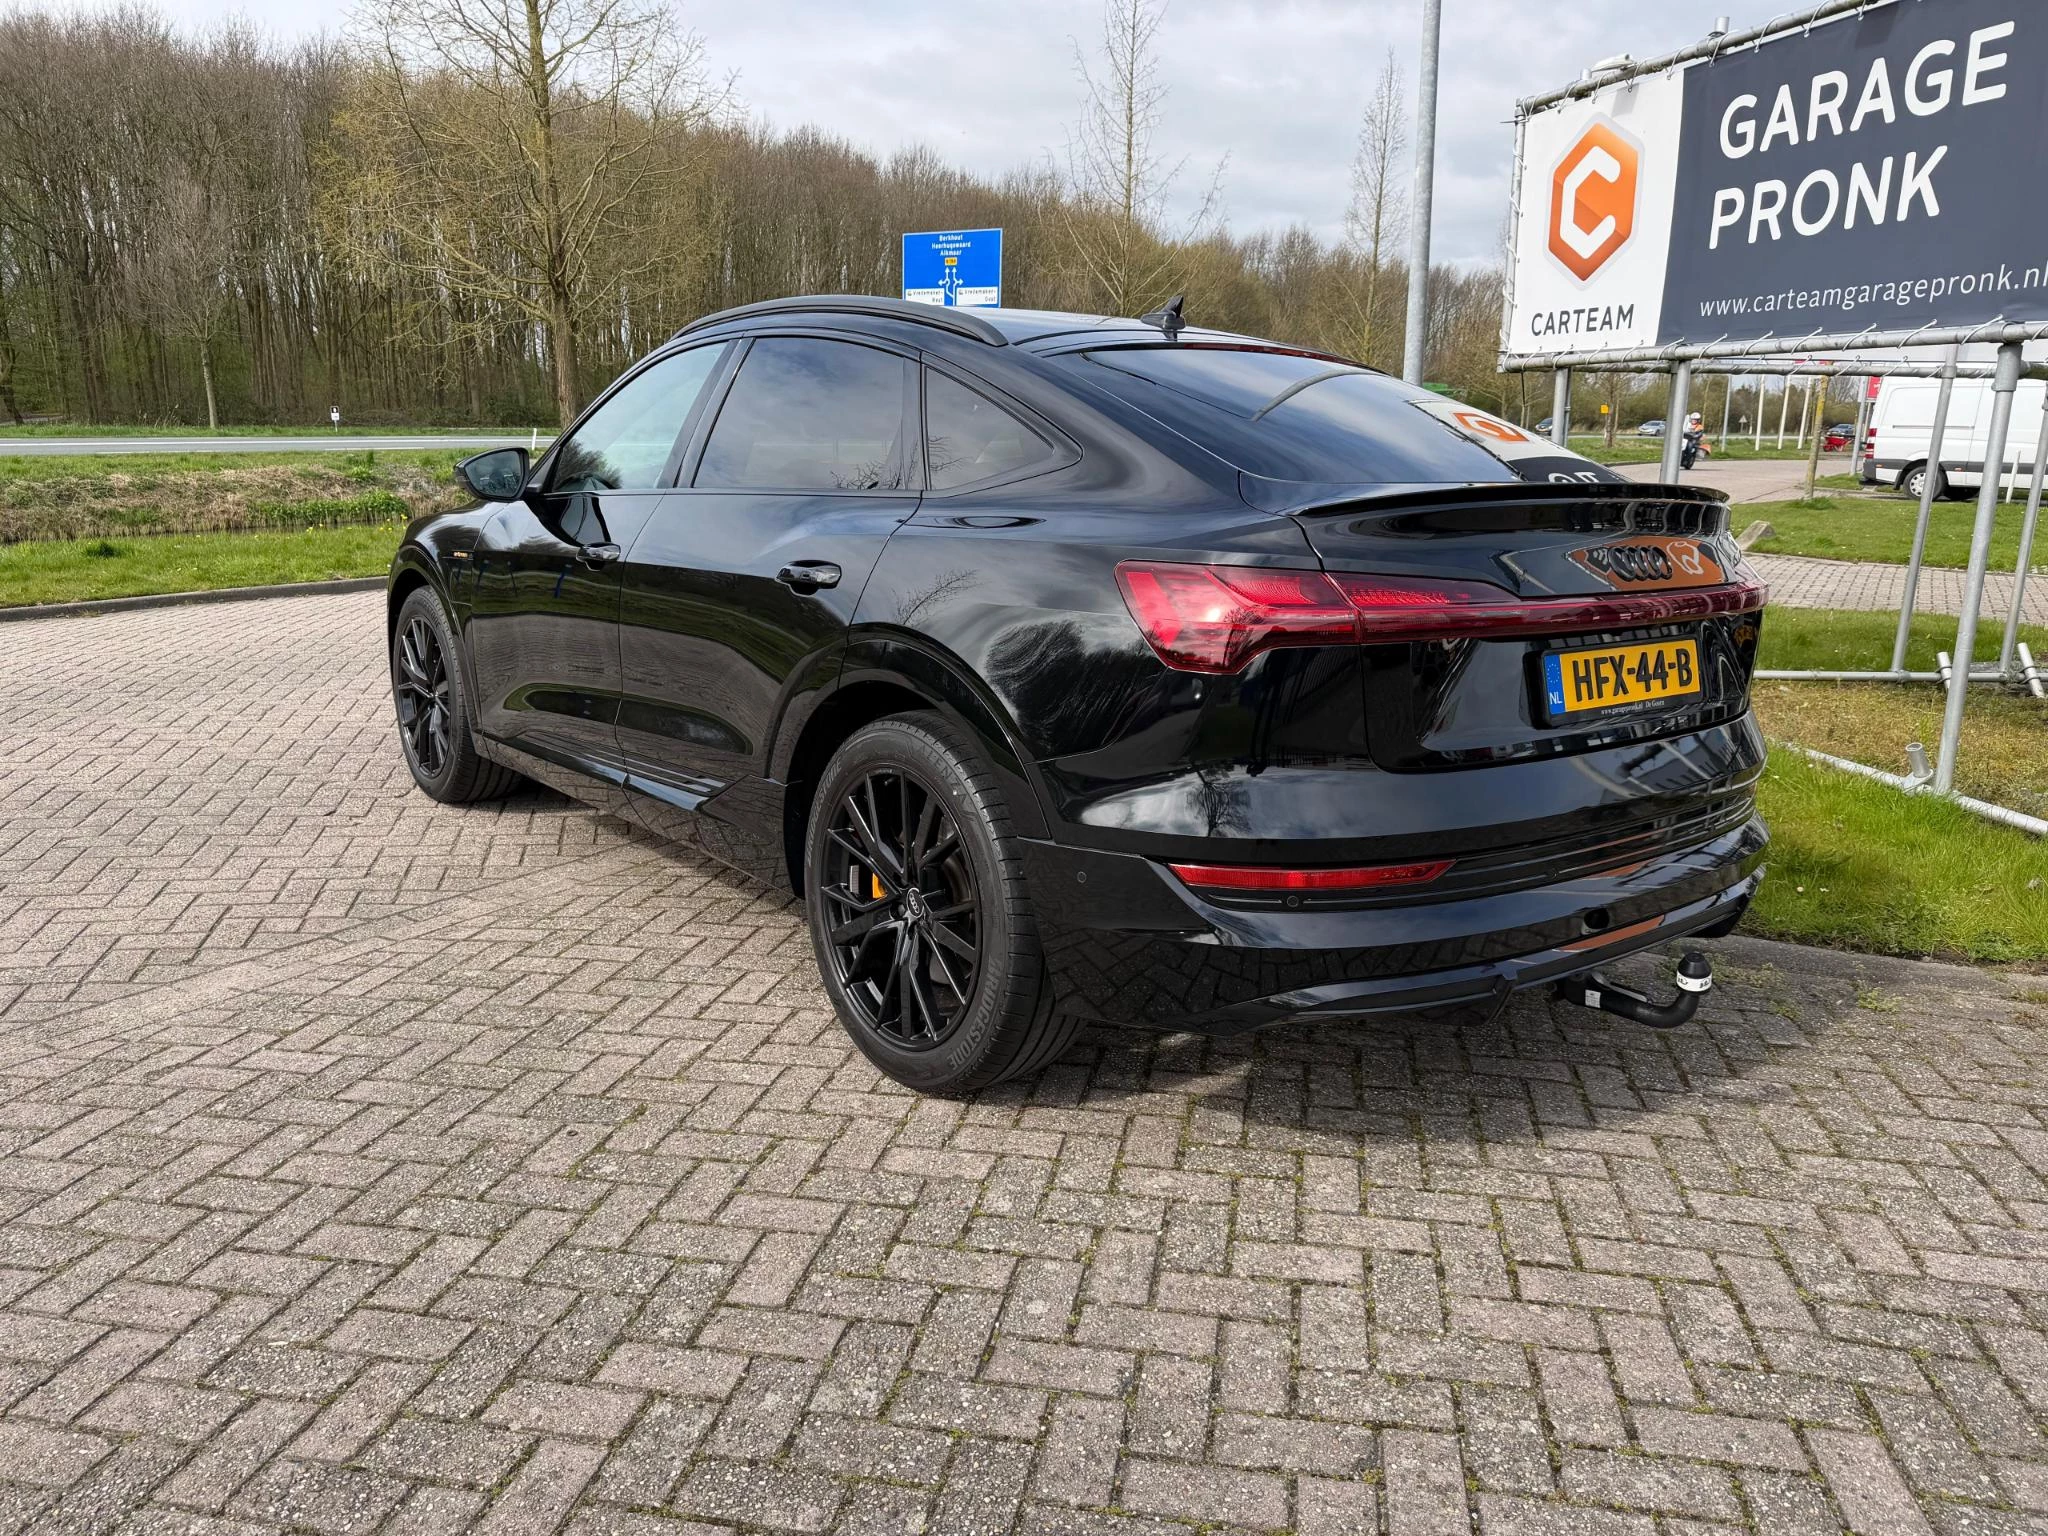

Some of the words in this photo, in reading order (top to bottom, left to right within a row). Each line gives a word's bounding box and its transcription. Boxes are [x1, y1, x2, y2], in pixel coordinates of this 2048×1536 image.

[1719, 20, 2015, 159] GARAGE
[1708, 145, 1948, 250] PRONK
[939, 234, 963, 242] Berkhout
[1699, 259, 2048, 317] www.carteamgaragepronk.nl
[1531, 303, 1635, 337] CARTEAM
[1549, 691, 1563, 705] NL
[1572, 648, 1693, 703] HFX-44-B
[946, 953, 1003, 1072] BRIDGESTONE
